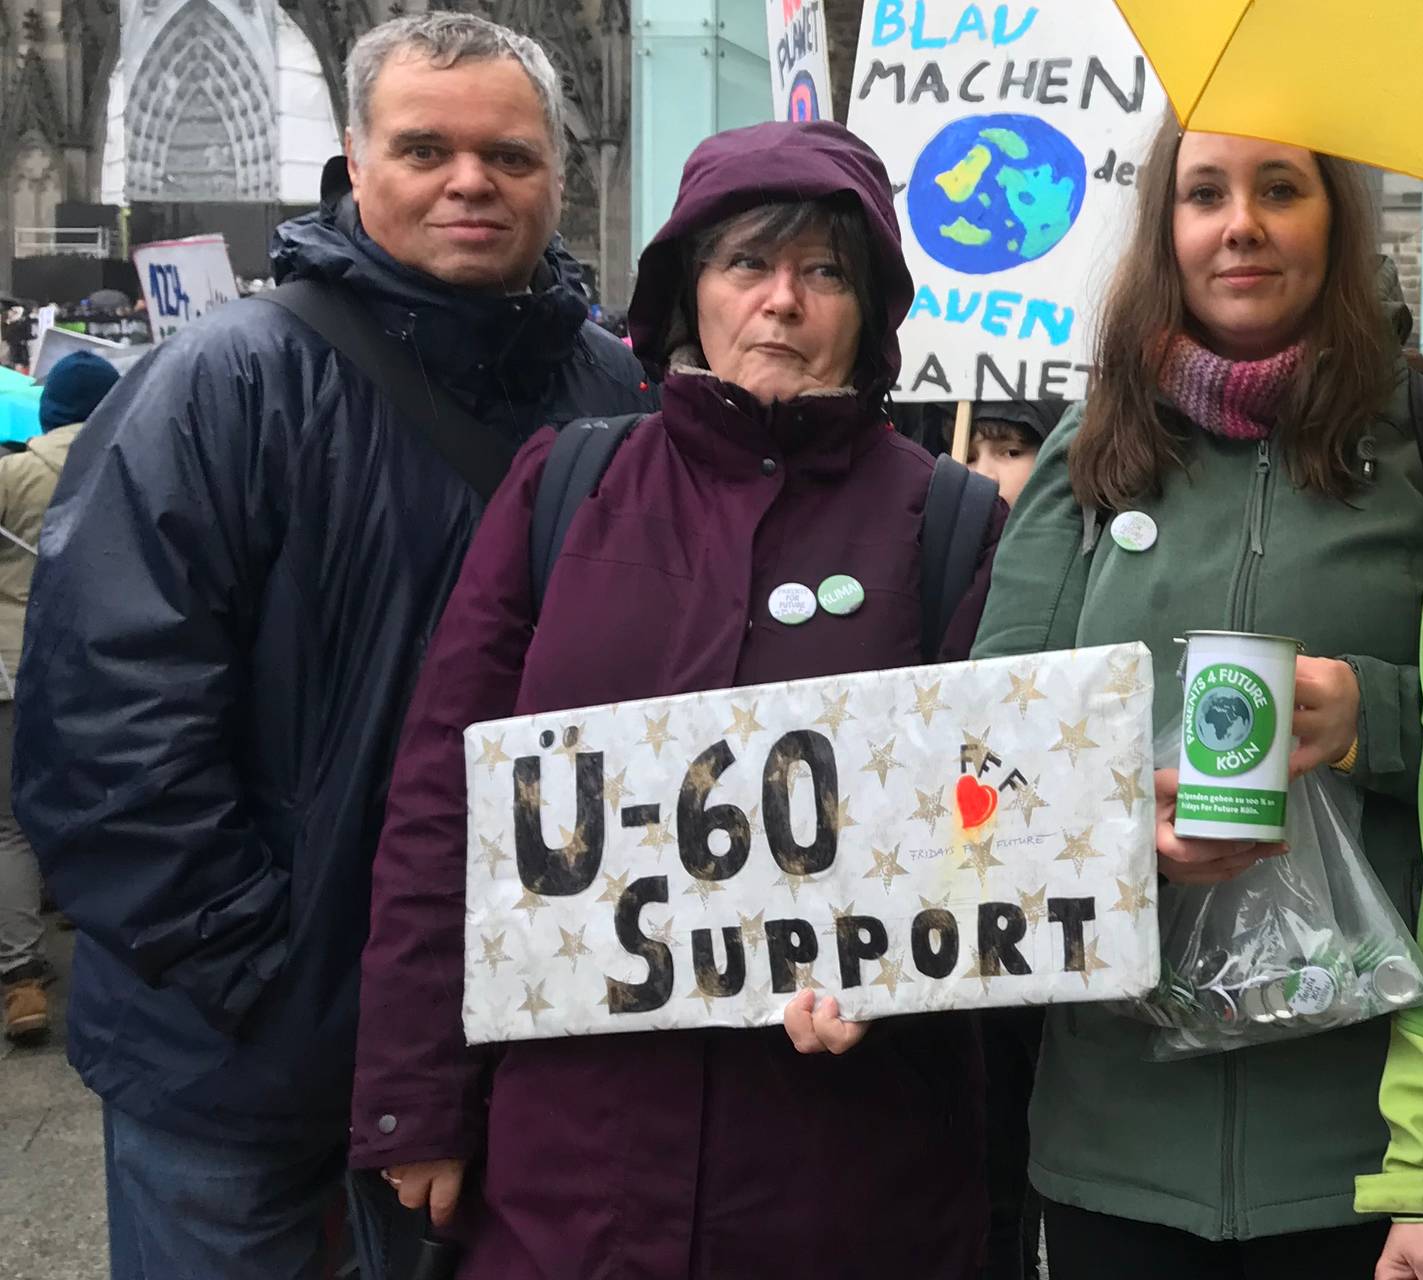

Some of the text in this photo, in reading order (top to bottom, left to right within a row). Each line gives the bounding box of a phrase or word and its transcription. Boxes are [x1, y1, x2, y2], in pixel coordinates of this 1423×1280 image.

[777, 1, 819, 90] PLANET
[871, 0, 1039, 49] BLAU
[859, 56, 1146, 113] MACHEN
[1094, 149, 1139, 190] de
[908, 285, 1075, 347] AUEN
[890, 352, 1104, 401] ANET
[1186, 668, 1268, 745] PARENTS 4 FUTURE
[1216, 742, 1261, 770] KÖLN
[513, 725, 840, 897] Ü-60
[606, 875, 1096, 1014] SUPPORT
